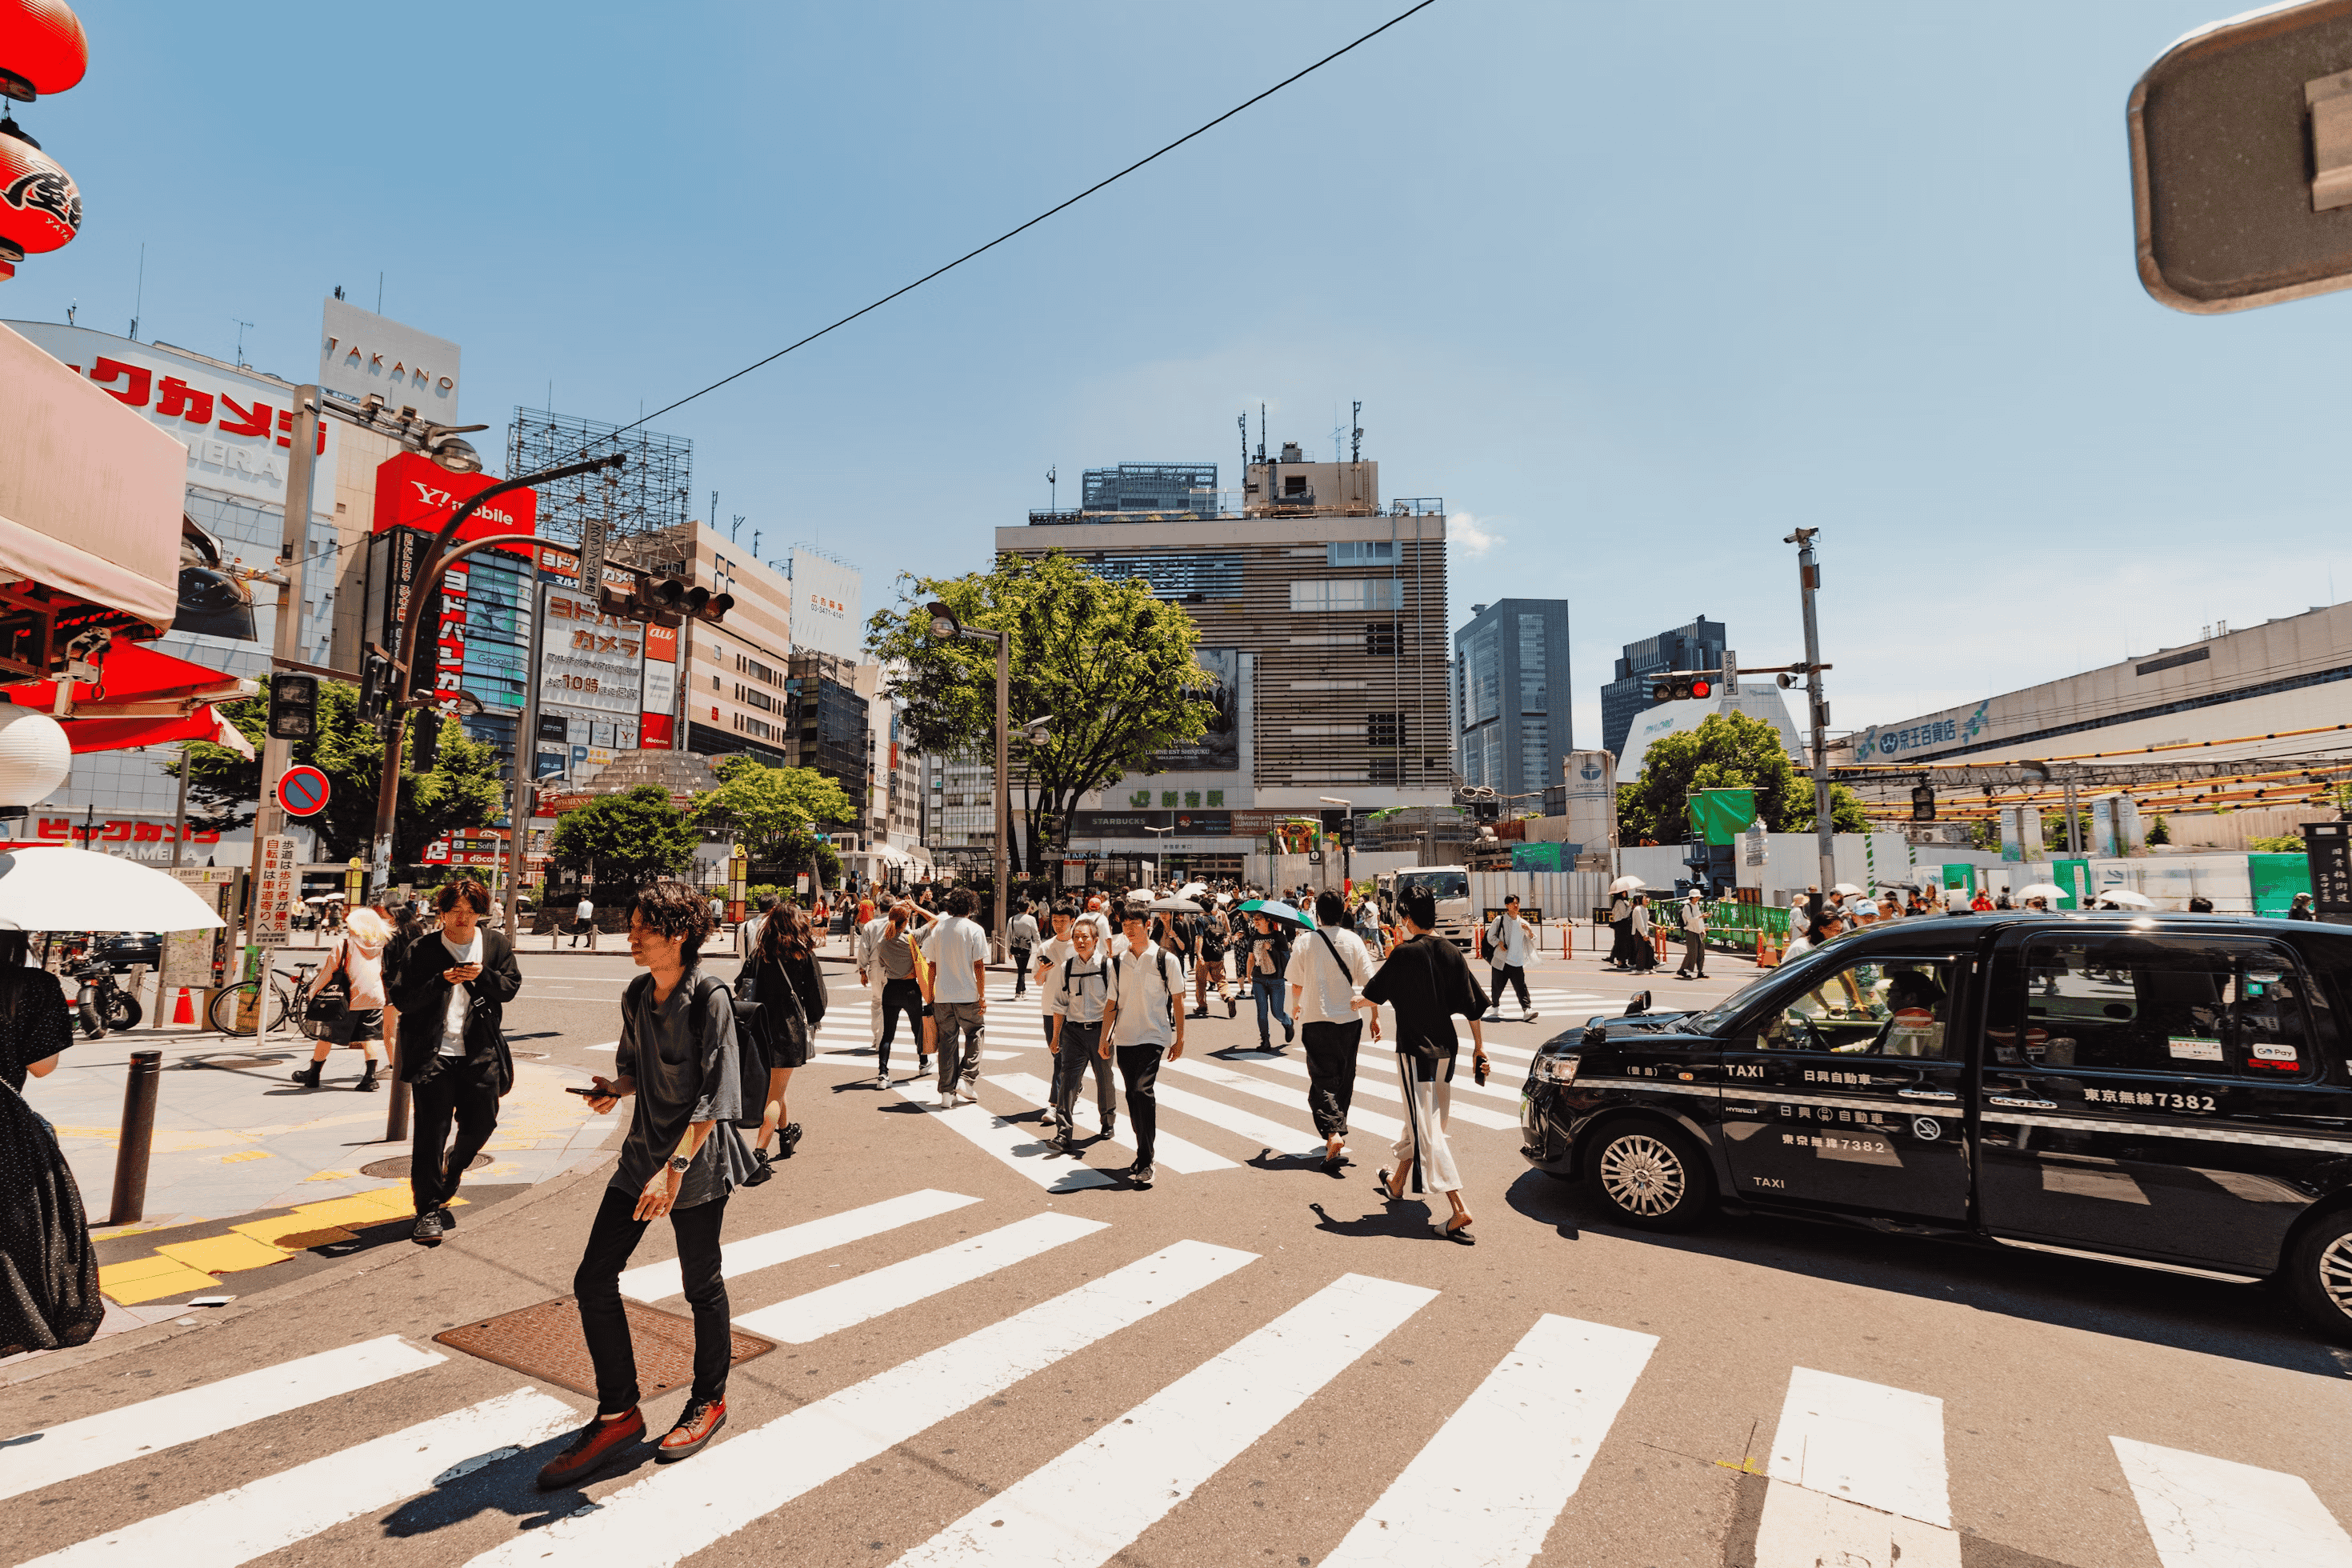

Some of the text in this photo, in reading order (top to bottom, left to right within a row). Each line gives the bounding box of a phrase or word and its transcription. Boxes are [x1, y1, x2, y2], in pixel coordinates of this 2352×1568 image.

[329, 335, 454, 390] TAKANO
[584, 522, 602, 594] スクランブル交差点
[1149, 561, 1194, 588] EST
[811, 594, 843, 612] 広告募集
[650, 628, 674, 640] au
[572, 630, 640, 658] カメラ
[478, 654, 511, 667] Google
[620, 731, 634, 740] Y!
[645, 736, 669, 745] docomo
[1898, 718, 1956, 750] 京王百貨店
[571, 745, 588, 769] P
[1129, 790, 1224, 808] JR 新宿駅
[110, 847, 198, 862] AMEA
[425, 840, 450, 860] 店
[478, 842, 510, 850] SoftBnk
[737, 845, 742, 854] 2
[470, 854, 506, 863] docoo
[258, 840, 278, 931] 自転車は車道寄りへ
[274, 840, 294, 931] 歩道は歩行者が優先
[2274, 1049, 2292, 1057] Pay
[1726, 1064, 1764, 1078] TAXI
[1804, 1070, 1872, 1085] 日興自動車
[2083, 1087, 2216, 1111] 東京無線7382
[1782, 1134, 1885, 1154] 東京無線7382
[1753, 1176, 1785, 1189] TAXI
